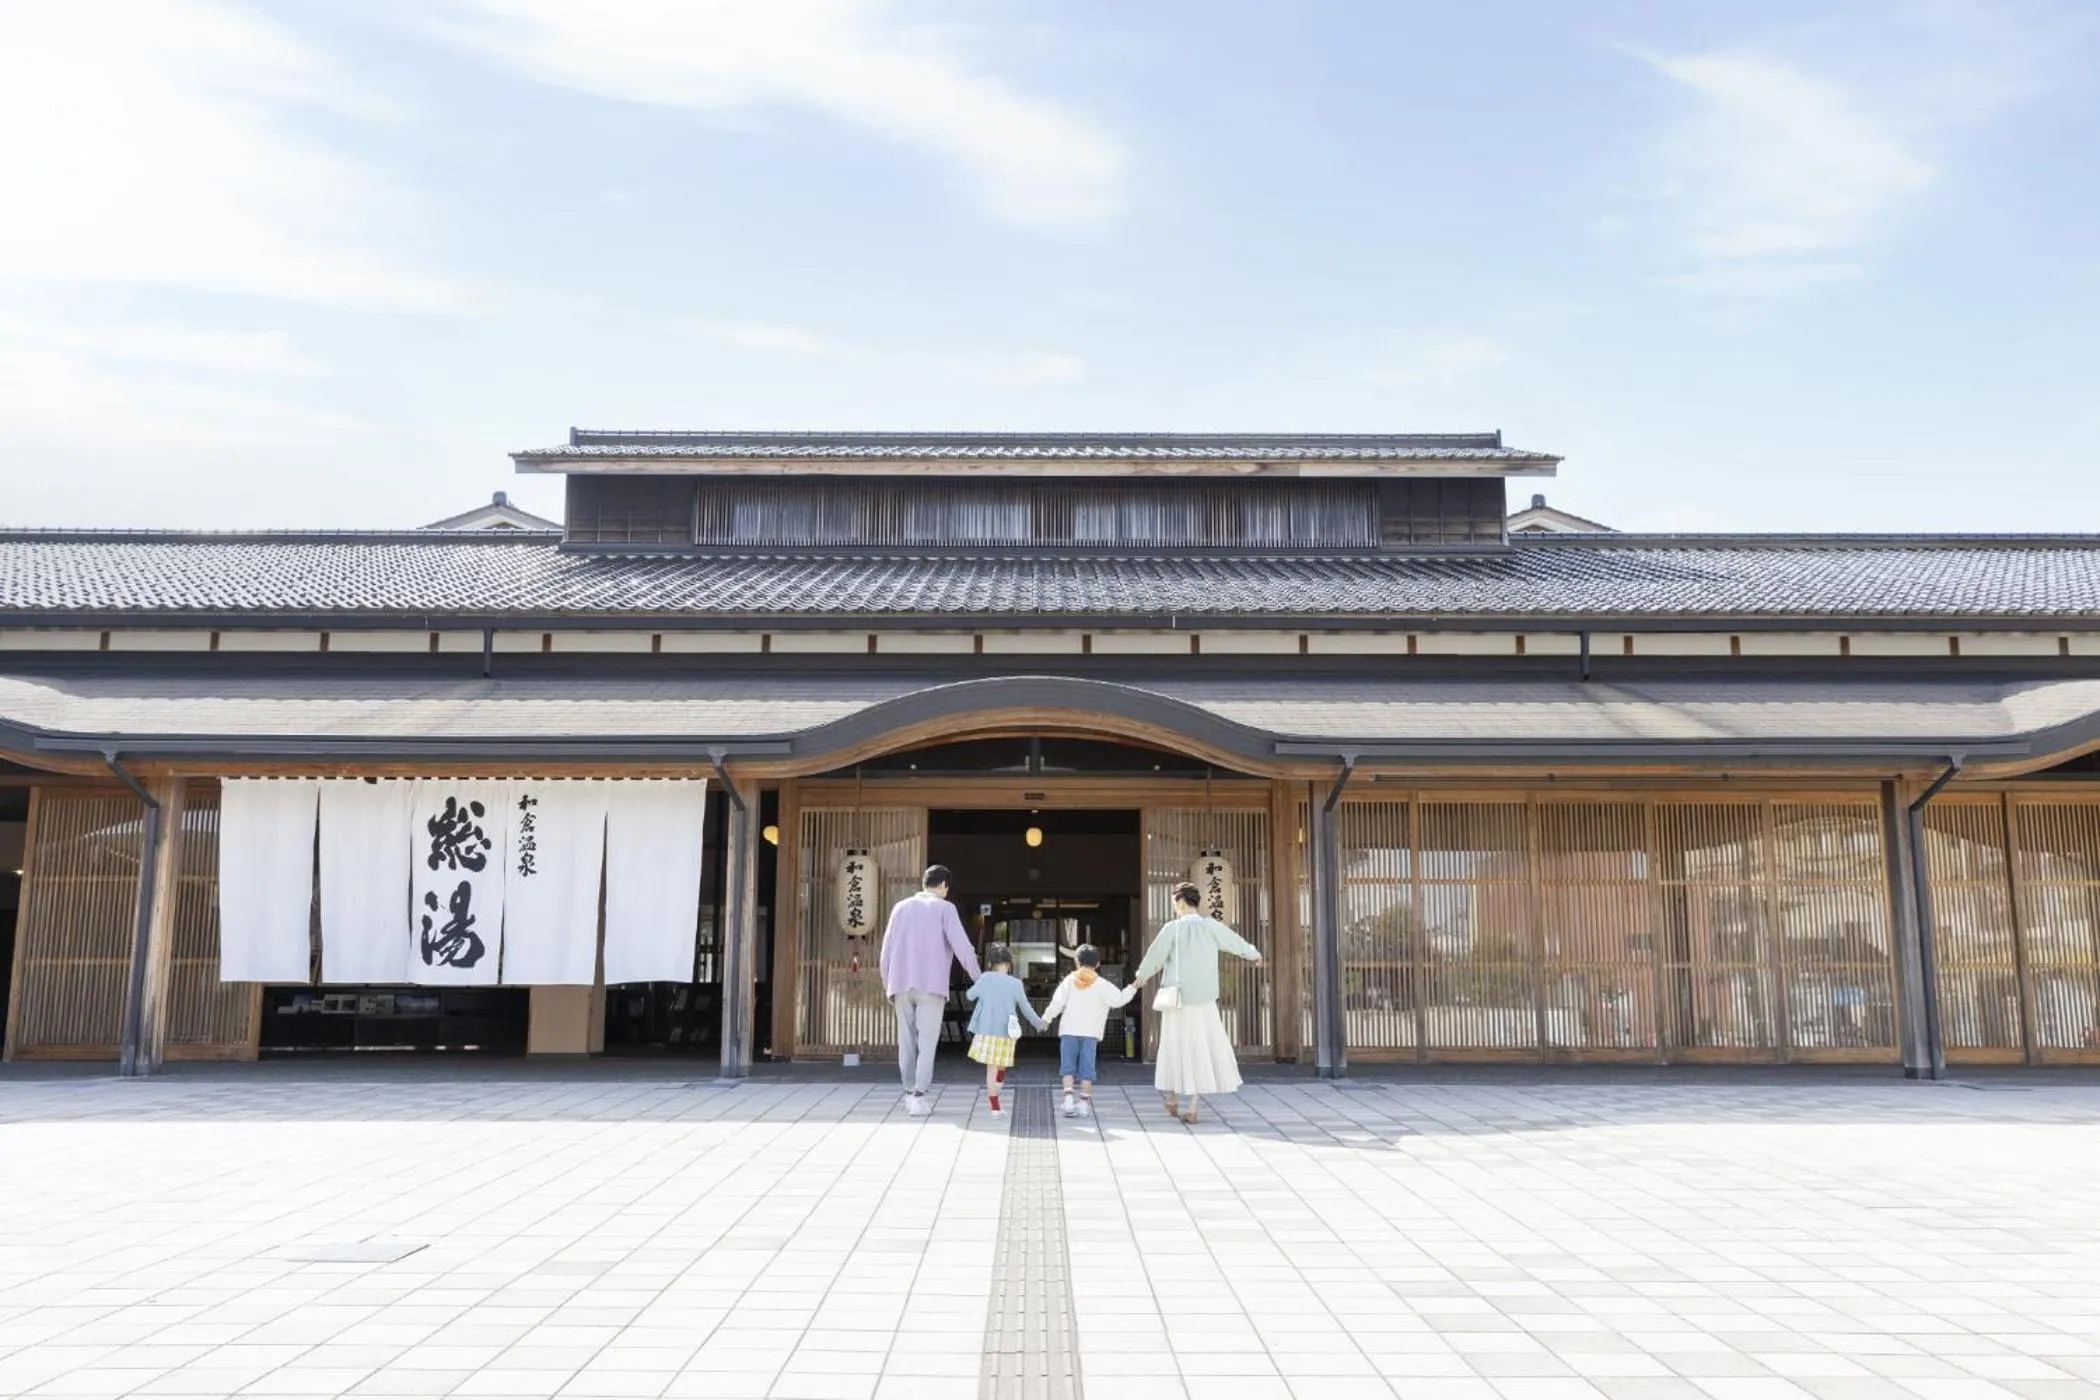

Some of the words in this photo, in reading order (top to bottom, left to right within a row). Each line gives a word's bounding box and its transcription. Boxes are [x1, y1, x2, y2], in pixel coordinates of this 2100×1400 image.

[518, 794, 539, 878] 和倉温泉
[421, 796, 492, 969] 総湯
[846, 861, 864, 929] 和倉温泉
